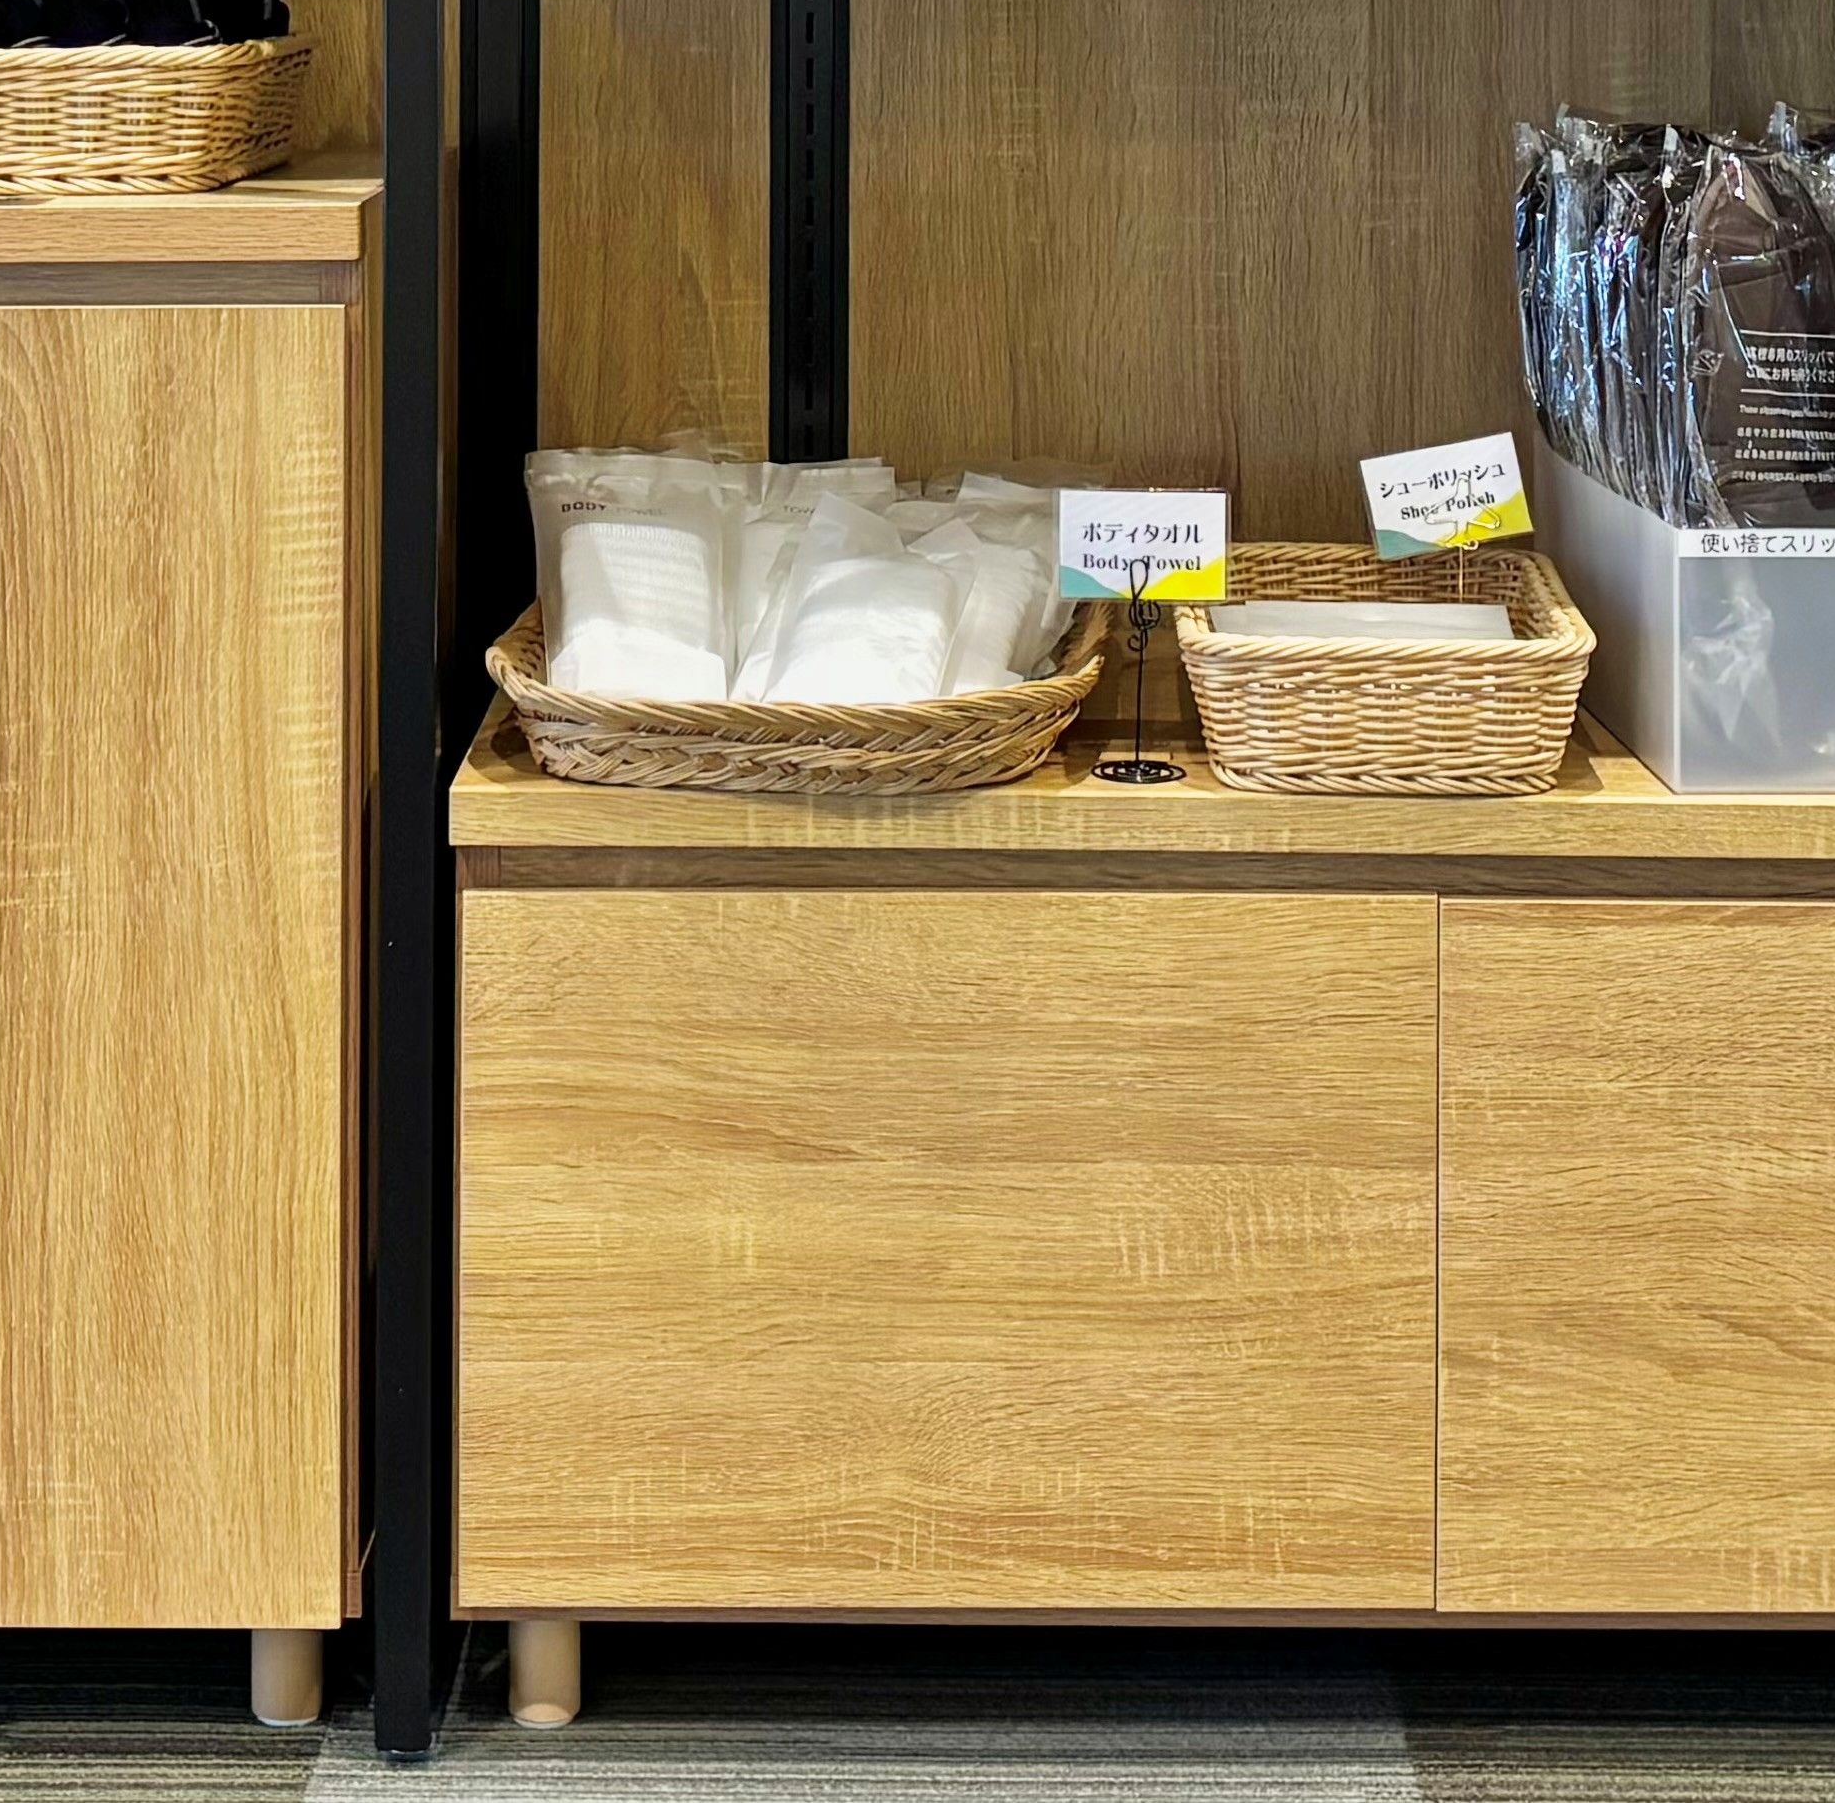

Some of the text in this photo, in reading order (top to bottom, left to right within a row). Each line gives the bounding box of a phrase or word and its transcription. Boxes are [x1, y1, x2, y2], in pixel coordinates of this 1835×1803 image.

[561, 501, 607, 514] BODY
[1400, 491, 1496, 520] Shoe Polish
[1083, 522, 1204, 544] ボディタオル
[1083, 553, 1201, 571] Body Towel
